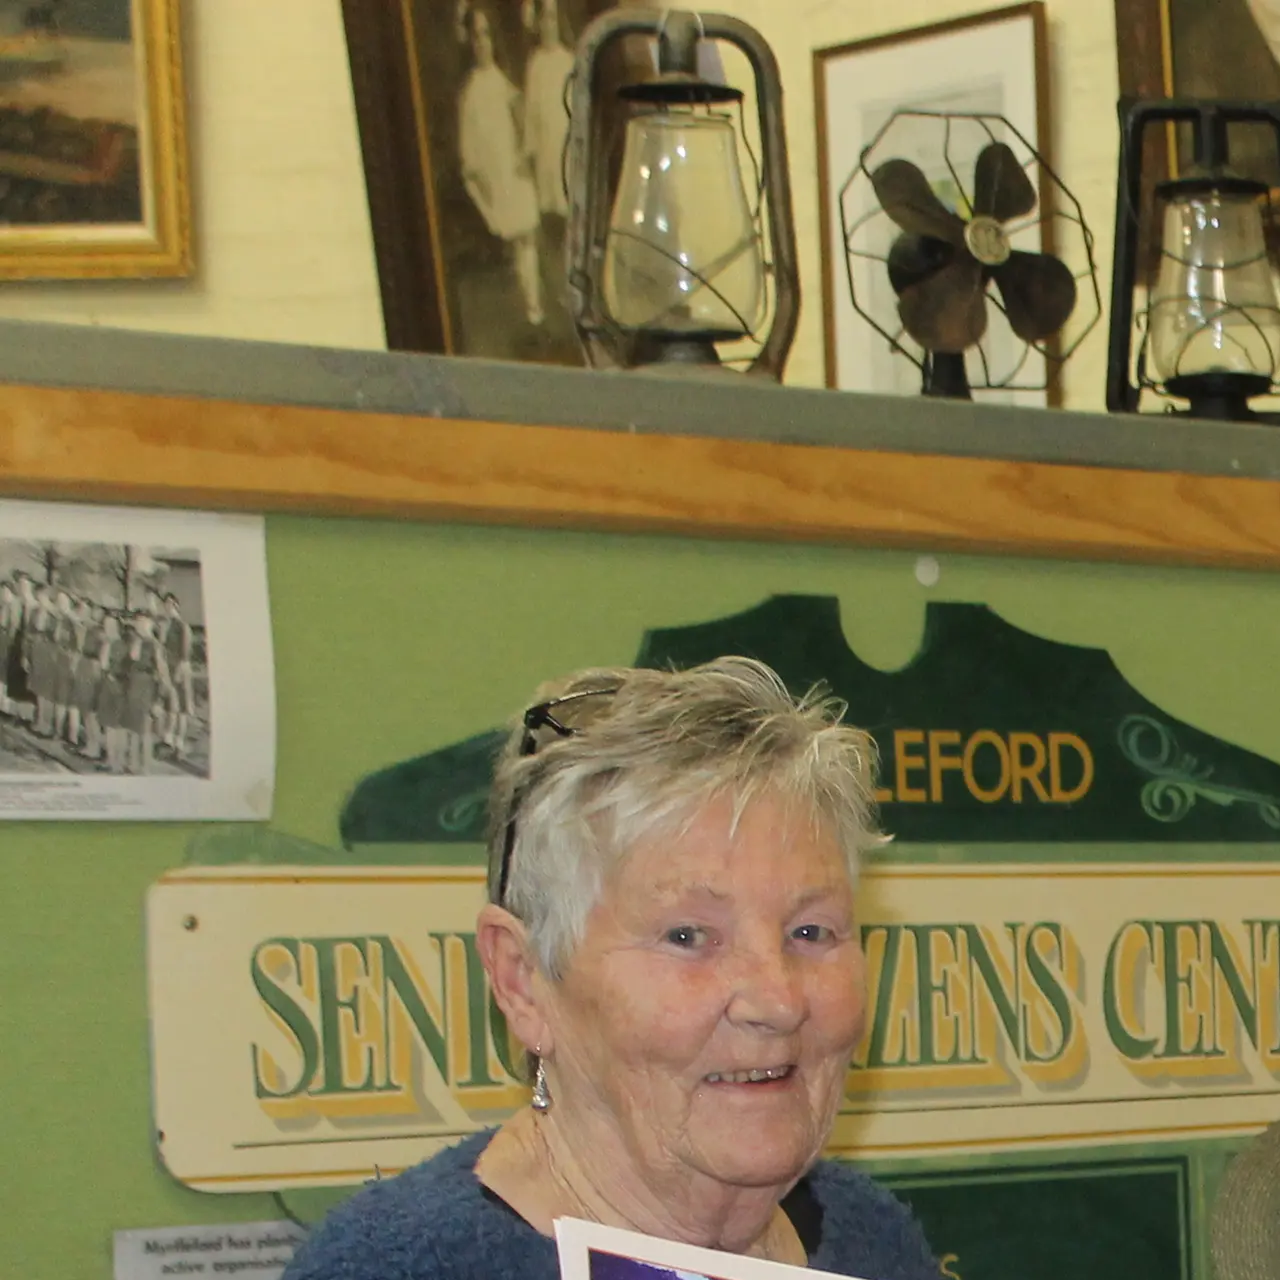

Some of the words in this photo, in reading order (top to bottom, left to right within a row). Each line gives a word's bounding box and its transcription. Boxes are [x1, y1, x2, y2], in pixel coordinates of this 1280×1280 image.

[875, 728, 1095, 804] EFORD
[251, 931, 525, 1100] SENI
[850, 921, 1073, 1069] ZENS
